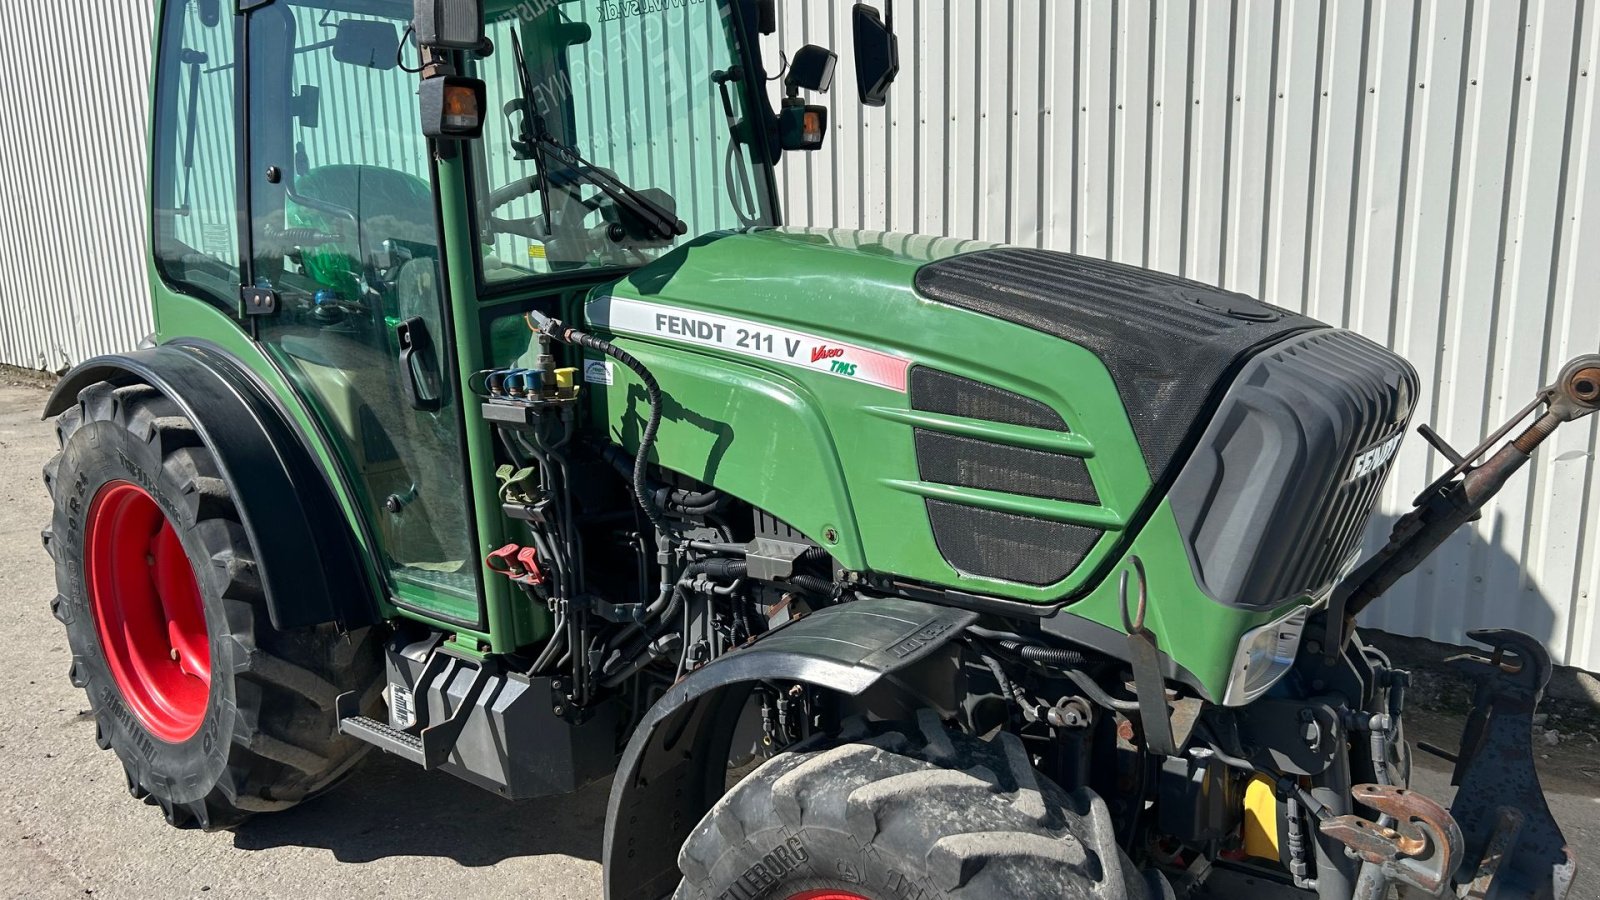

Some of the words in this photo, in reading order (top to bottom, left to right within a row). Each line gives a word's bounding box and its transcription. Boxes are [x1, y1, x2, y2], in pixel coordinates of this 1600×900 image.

[656, 313, 726, 343] FENDT
[737, 329, 773, 353] 211
[785, 337, 800, 357] V
[831, 360, 857, 376] TMS
[1349, 432, 1402, 482] FENDT
